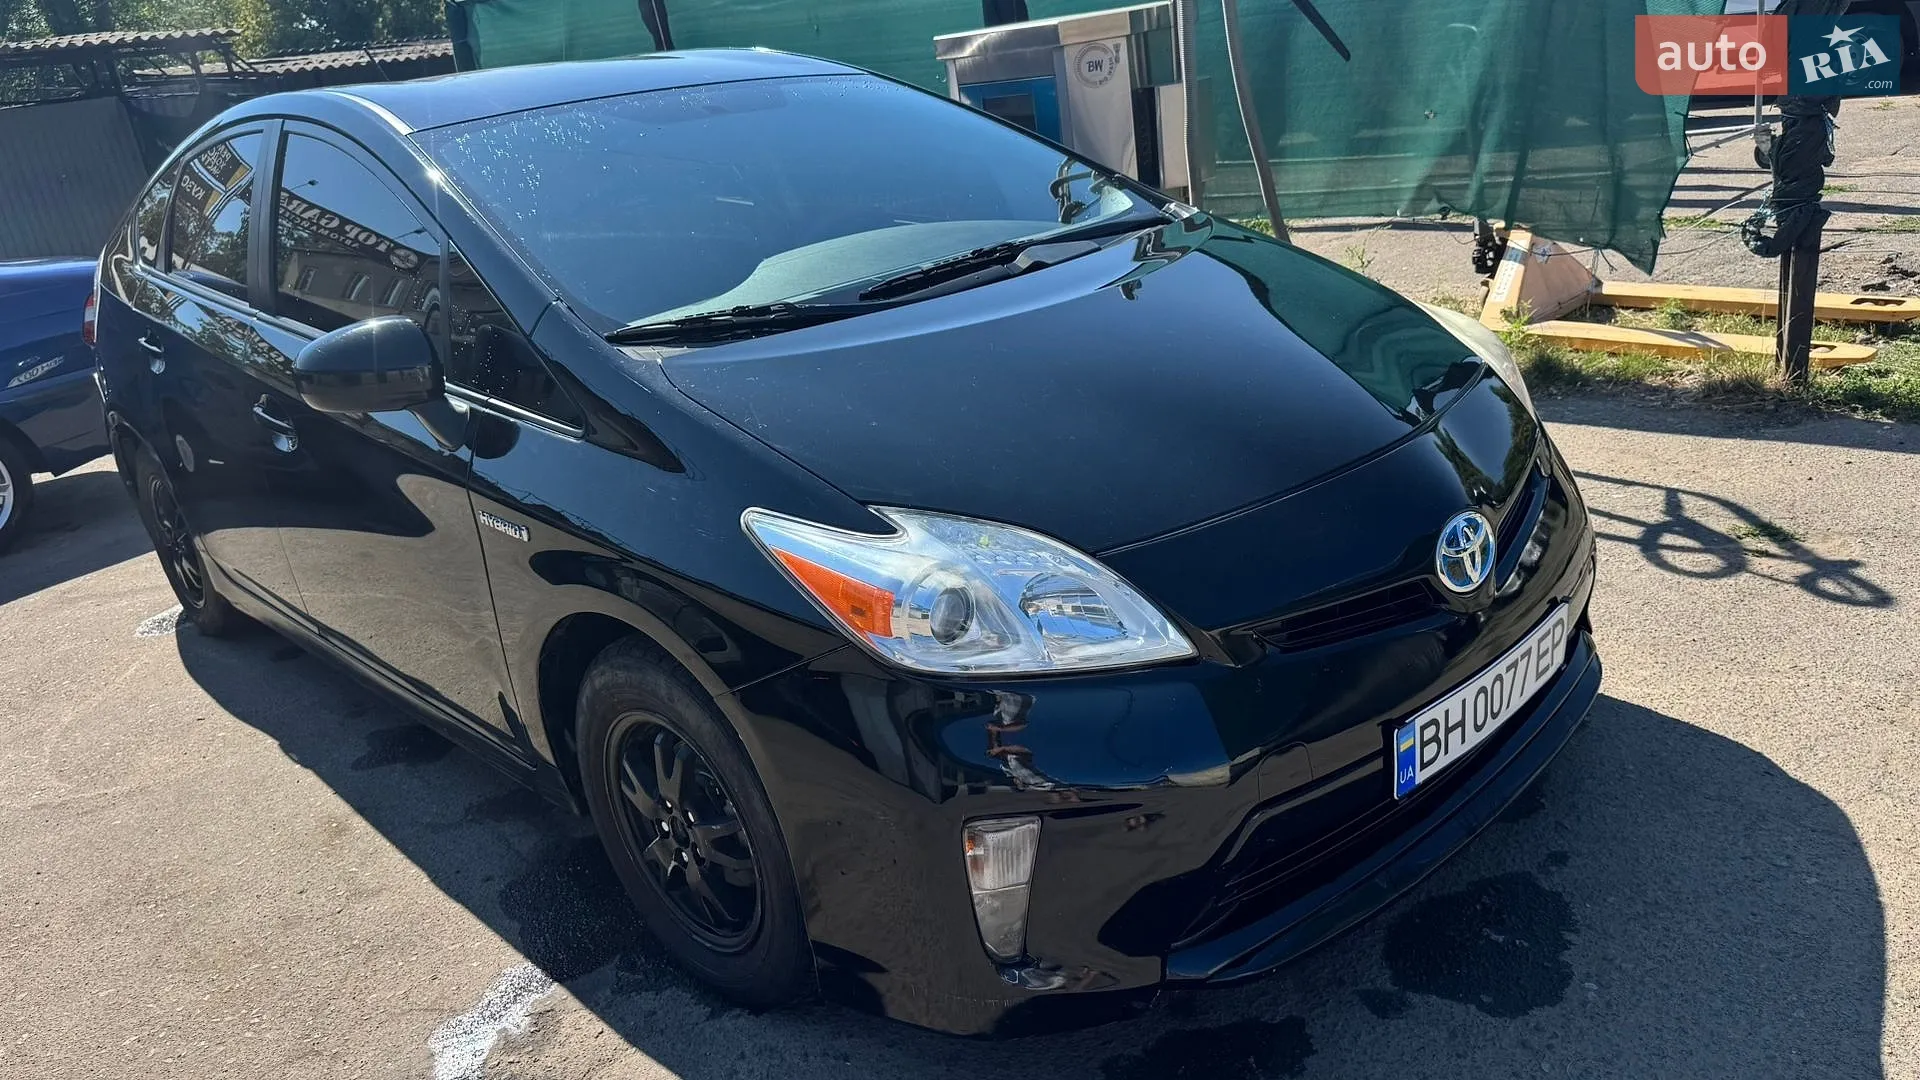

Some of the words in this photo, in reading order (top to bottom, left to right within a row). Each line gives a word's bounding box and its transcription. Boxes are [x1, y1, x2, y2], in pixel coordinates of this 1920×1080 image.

[1086, 59, 1103, 72] BW
[479, 511, 521, 539] HYBRID
[1419, 698, 1467, 773] BH
[1473, 646, 1532, 733] 0077
[1535, 618, 1566, 682] EP
[1400, 764, 1414, 784] UA
